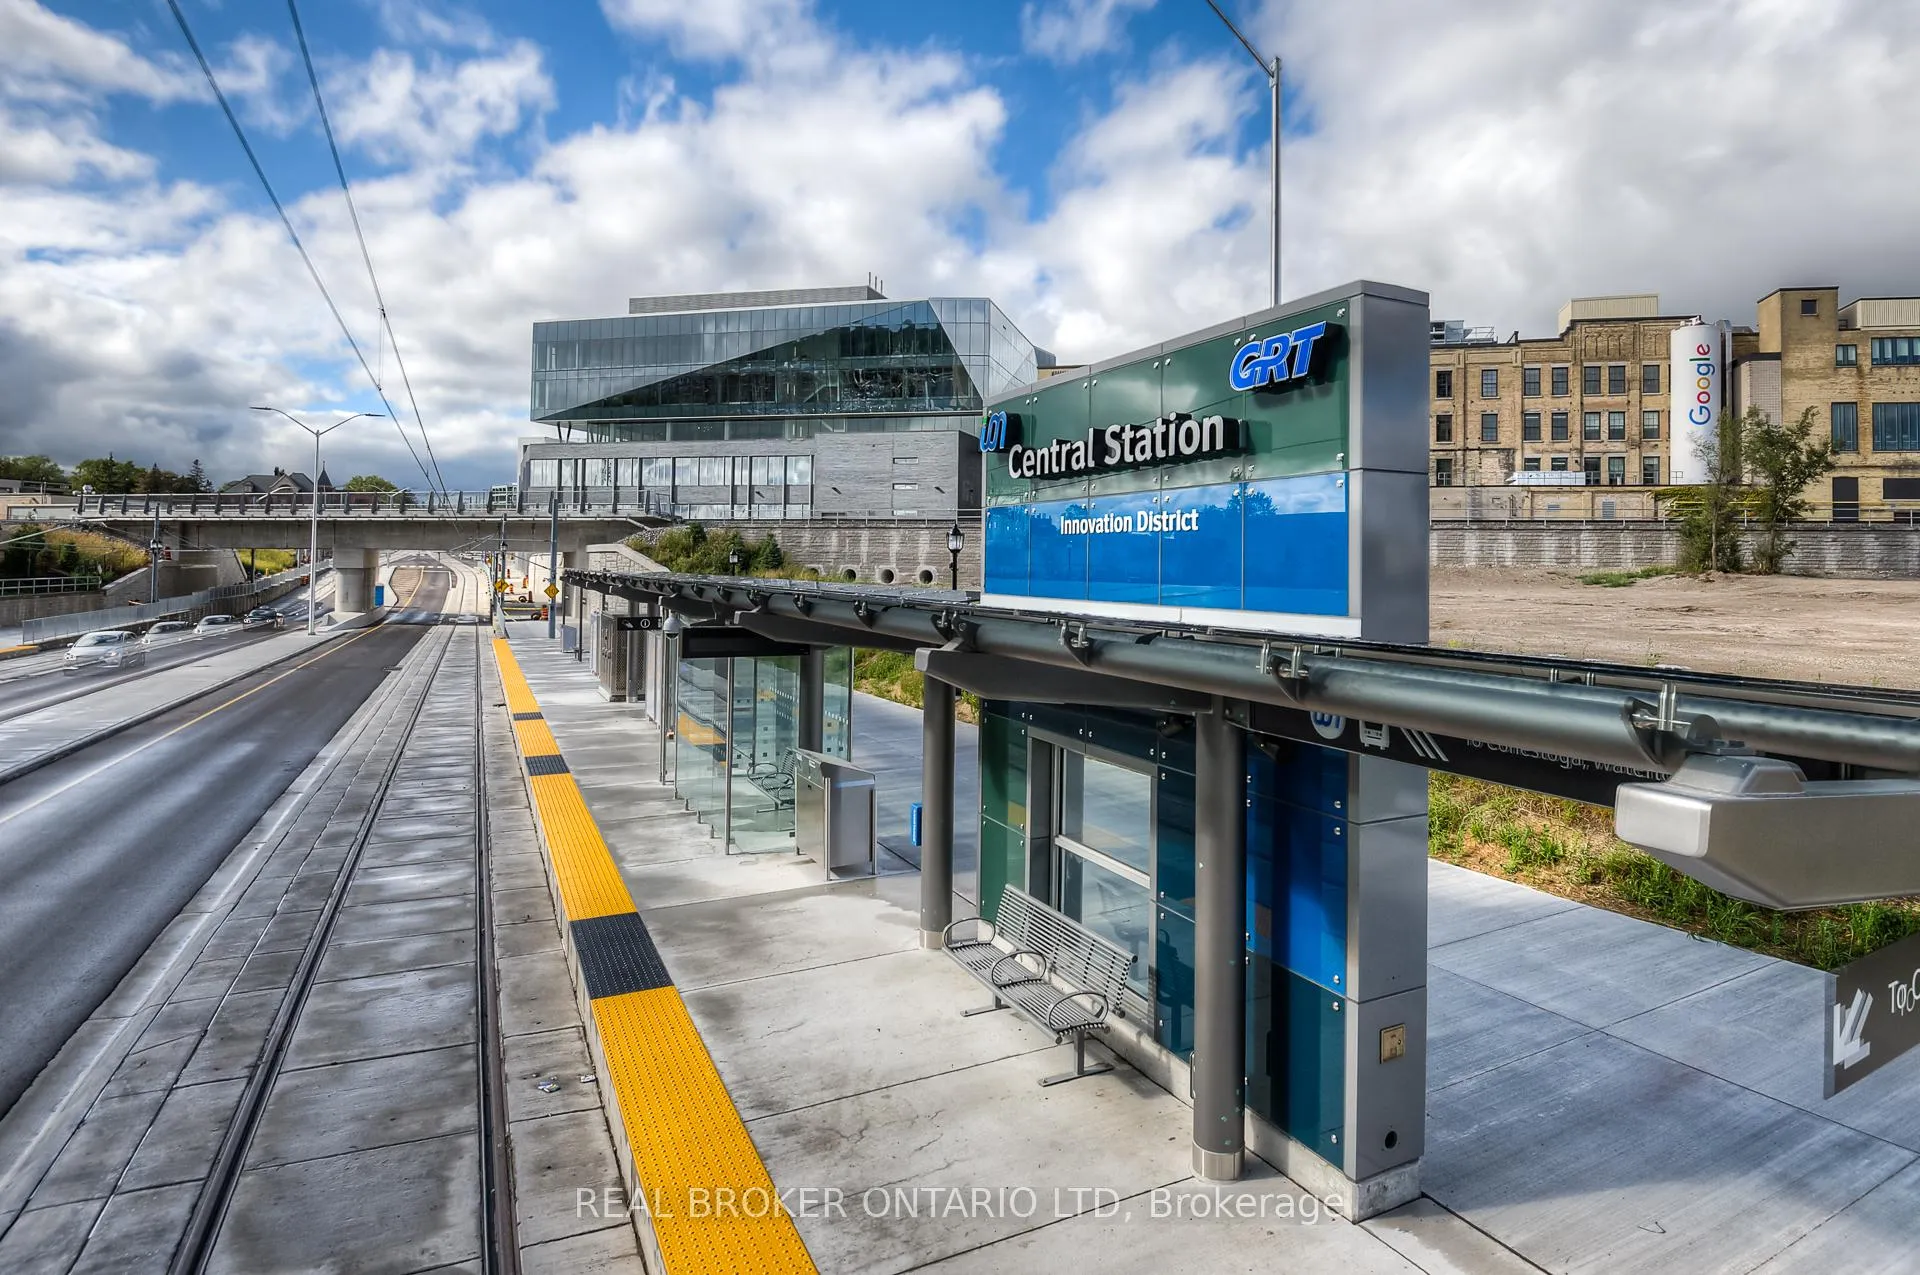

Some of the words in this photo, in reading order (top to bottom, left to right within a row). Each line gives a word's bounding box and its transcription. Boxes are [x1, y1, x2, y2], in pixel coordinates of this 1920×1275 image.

[1229, 320, 1327, 392] GRT
[1689, 343, 1716, 426] Google
[1008, 427, 1095, 480] Central
[1104, 411, 1225, 466] Station
[1060, 513, 1133, 535] Innovation
[1137, 508, 1199, 533] District
